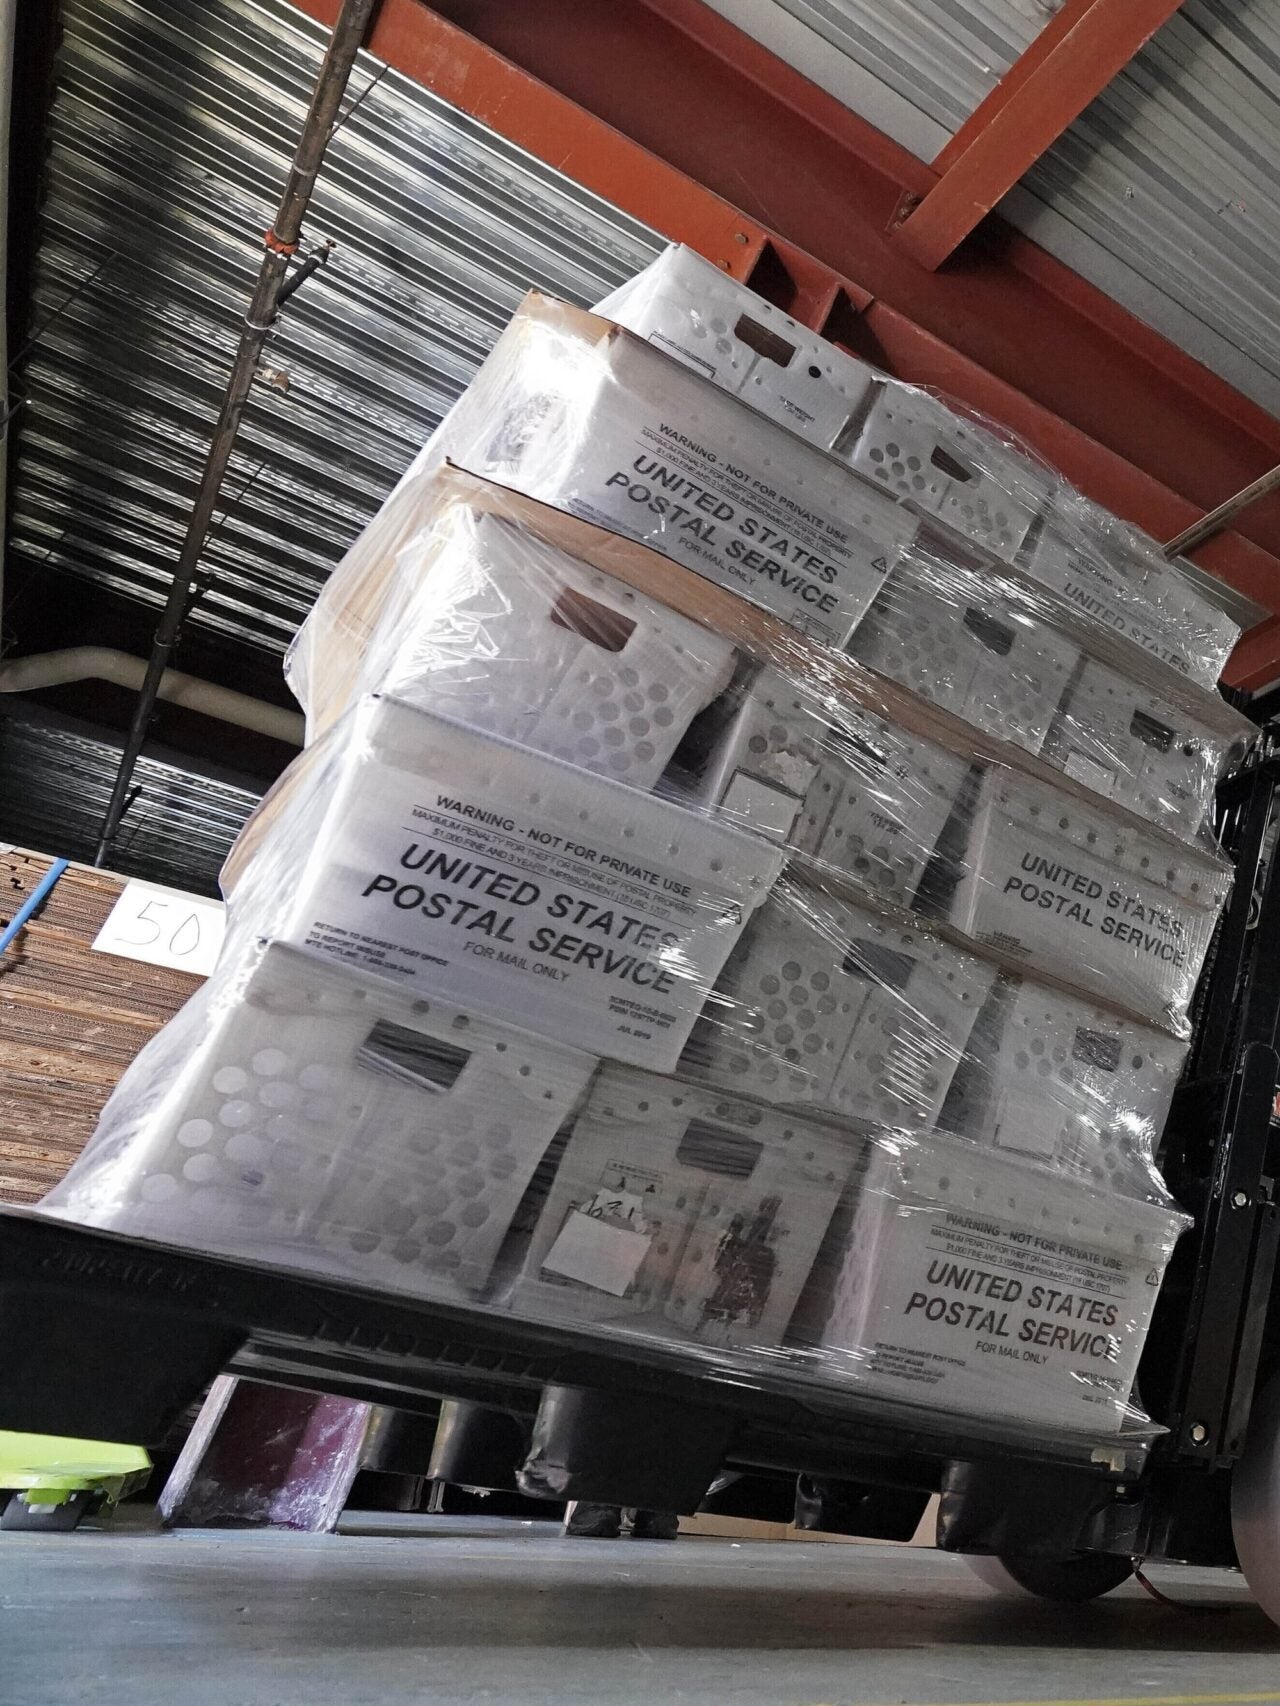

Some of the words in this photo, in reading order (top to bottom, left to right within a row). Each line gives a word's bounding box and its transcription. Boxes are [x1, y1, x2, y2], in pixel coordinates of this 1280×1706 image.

[660, 423, 717, 463] WARNING
[726, 464, 750, 483] NOT
[752, 480, 777, 498] FOR
[779, 496, 825, 528] PRIVATE
[826, 525, 849, 544] USE
[605, 472, 715, 546] POSTAL
[726, 540, 838, 613] SERVICE
[633, 455, 734, 521] UNITED
[739, 518, 837, 583] STATES
[678, 537, 702, 555] FOR
[703, 552, 729, 569] MAIL
[727, 566, 757, 585] ONLY
[1063, 582, 1124, 630] UNITED
[1131, 631, 1189, 674] STATES
[412, 809, 460, 830] MAXIMUM
[461, 825, 503, 843] PENALTY
[504, 838, 526, 851] FOR
[528, 844, 556, 861] THEFT
[432, 828, 463, 845] $1,000
[463, 840, 486, 851] FINE
[487, 847, 508, 859] AND
[516, 857, 547, 874] YEARS
[437, 795, 515, 832] WARNING
[528, 828, 562, 848] NOT
[564, 841, 597, 861] FOR
[600, 854, 660, 885] PRIVATE
[663, 877, 692, 898] USE
[400, 844, 540, 905] UNITED
[1021, 853, 1102, 899] UNITED
[1106, 890, 1186, 938] STATES
[114, 900, 202, 956] 50
[362, 875, 514, 942] POSTAL
[529, 926, 679, 994] SERVICE
[1003, 877, 1093, 927] POSTAL
[1101, 917, 1185, 968] SERVICE
[464, 941, 497, 960] FOR
[499, 951, 530, 972] MAIL
[533, 962, 570, 983] ONLY
[946, 1213, 1000, 1237] WARNING
[1009, 1231, 1032, 1245] NOT
[1035, 1237, 1057, 1252] FOR
[1059, 1244, 1101, 1265] PRIVATE
[1103, 1257, 1122, 1270] USE
[904, 1292, 1009, 1336] POSTAL
[927, 1260, 1022, 1302] UNITED
[1028, 1286, 1118, 1326] STATES
[974, 1340, 997, 1354] FOR
[998, 1346, 1021, 1361] MAIL
[1023, 1351, 1049, 1366] ONLY
